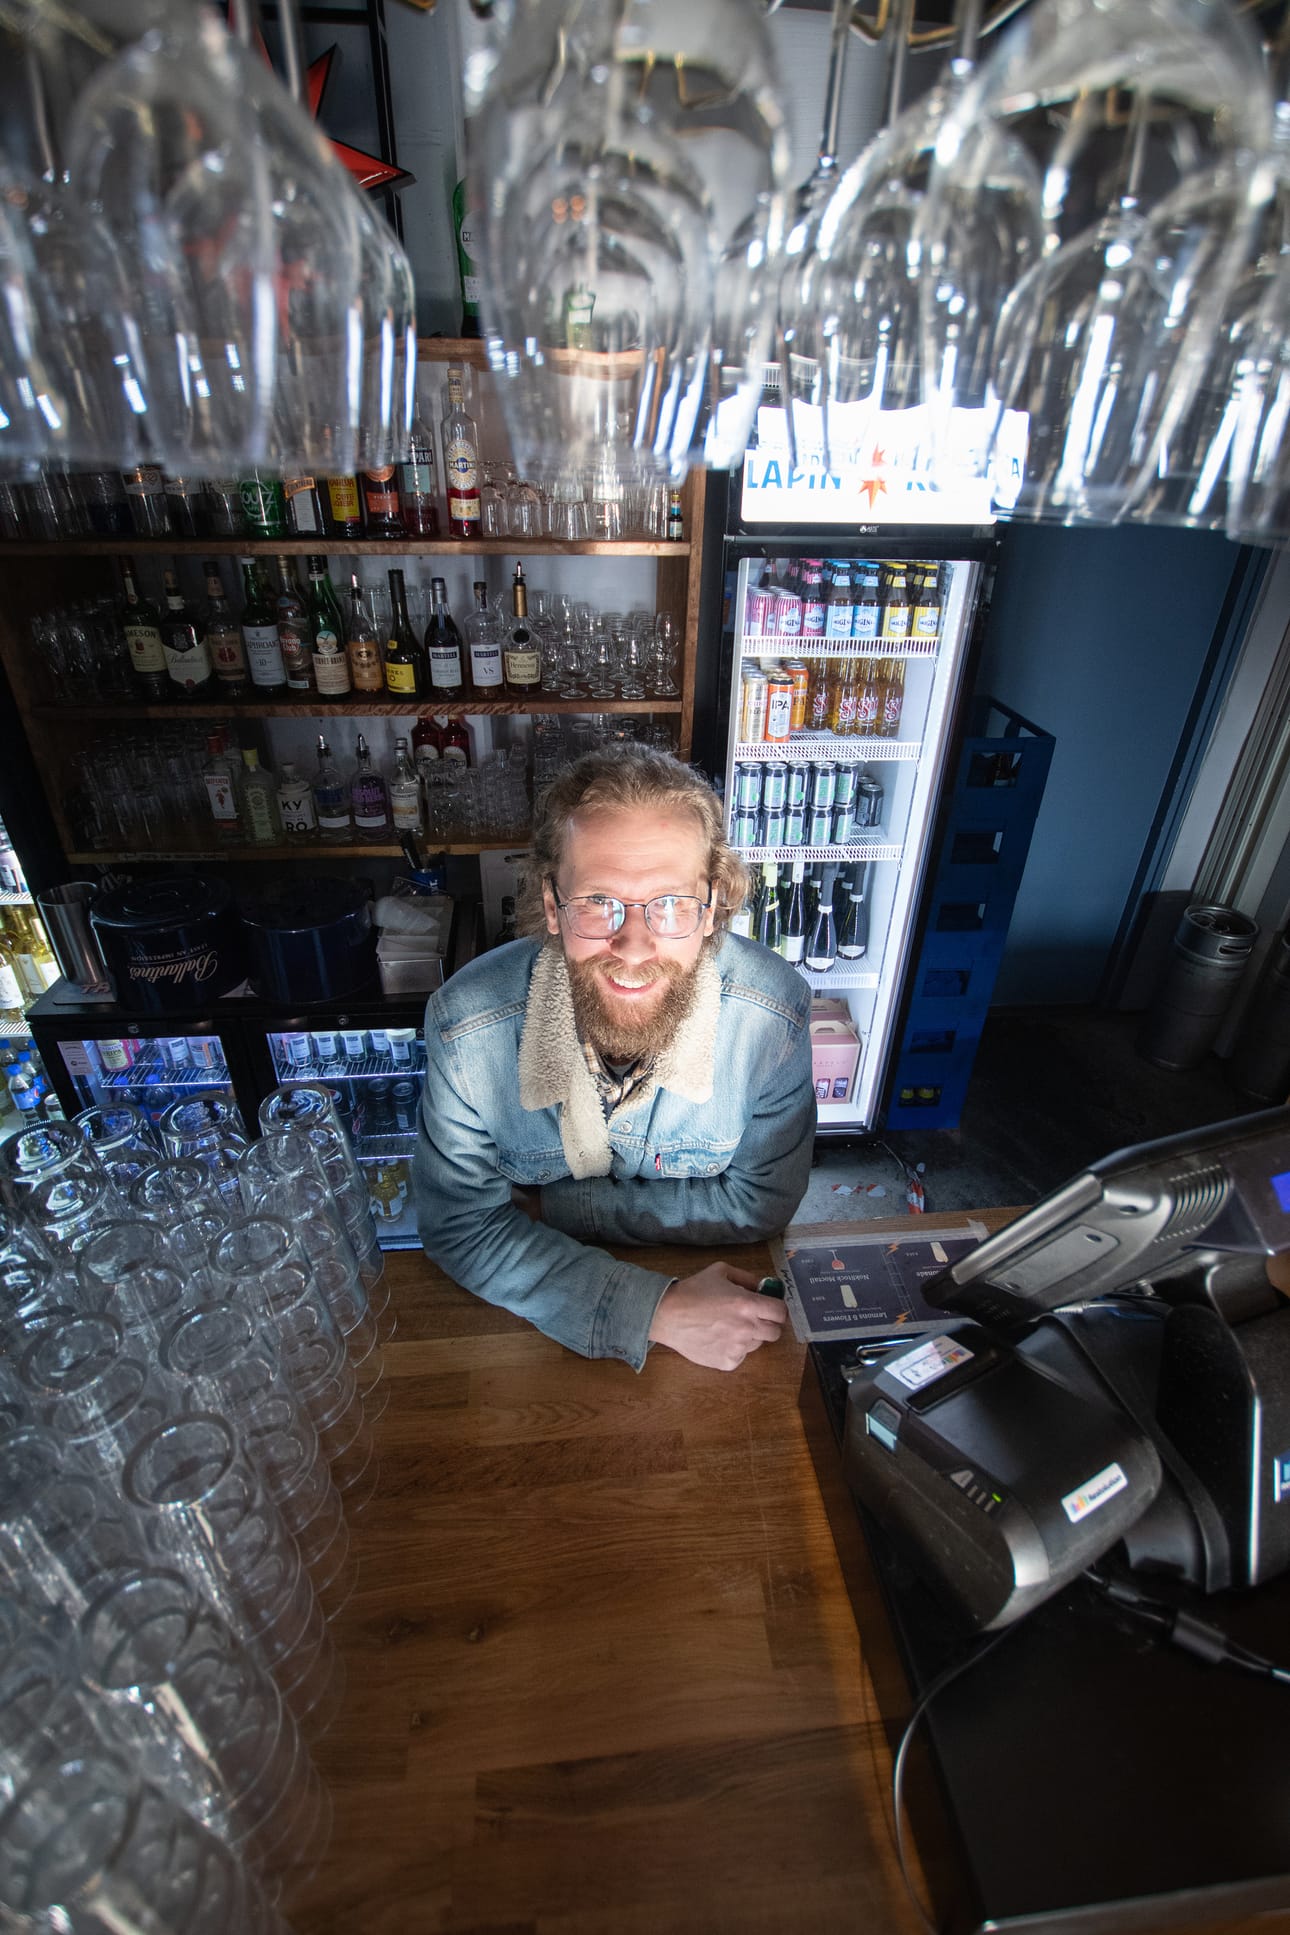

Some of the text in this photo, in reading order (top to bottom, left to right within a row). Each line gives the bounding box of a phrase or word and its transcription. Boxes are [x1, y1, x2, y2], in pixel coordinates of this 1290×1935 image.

[772, 699, 789, 710] IPA
[281, 800, 302, 810] KY
[128, 950, 217, 984] Ballantine's
[859, 1311, 888, 1319] Lemons
